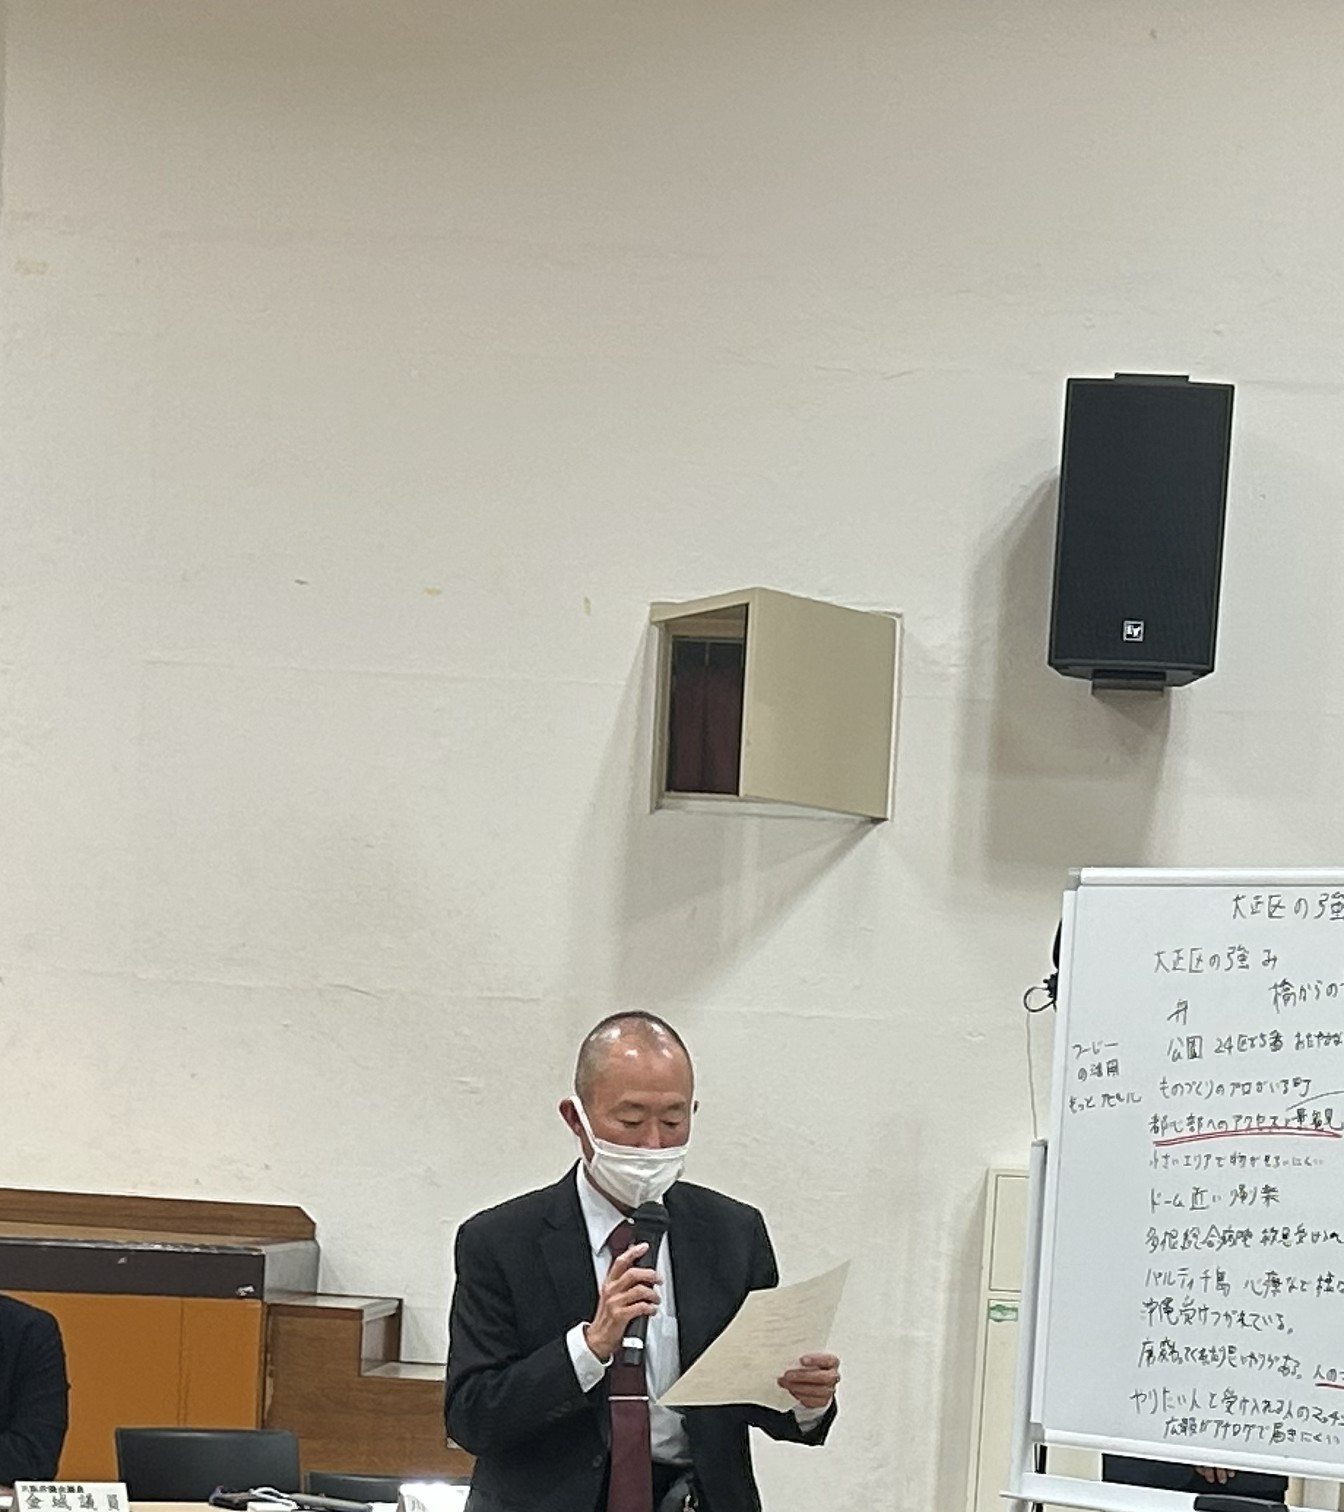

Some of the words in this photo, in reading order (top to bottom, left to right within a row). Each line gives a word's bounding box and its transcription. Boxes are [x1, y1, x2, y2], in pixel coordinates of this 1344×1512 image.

[1153, 945, 1278, 973] 大正区の強み
[25, 1492, 121, 1512] 金城議員
